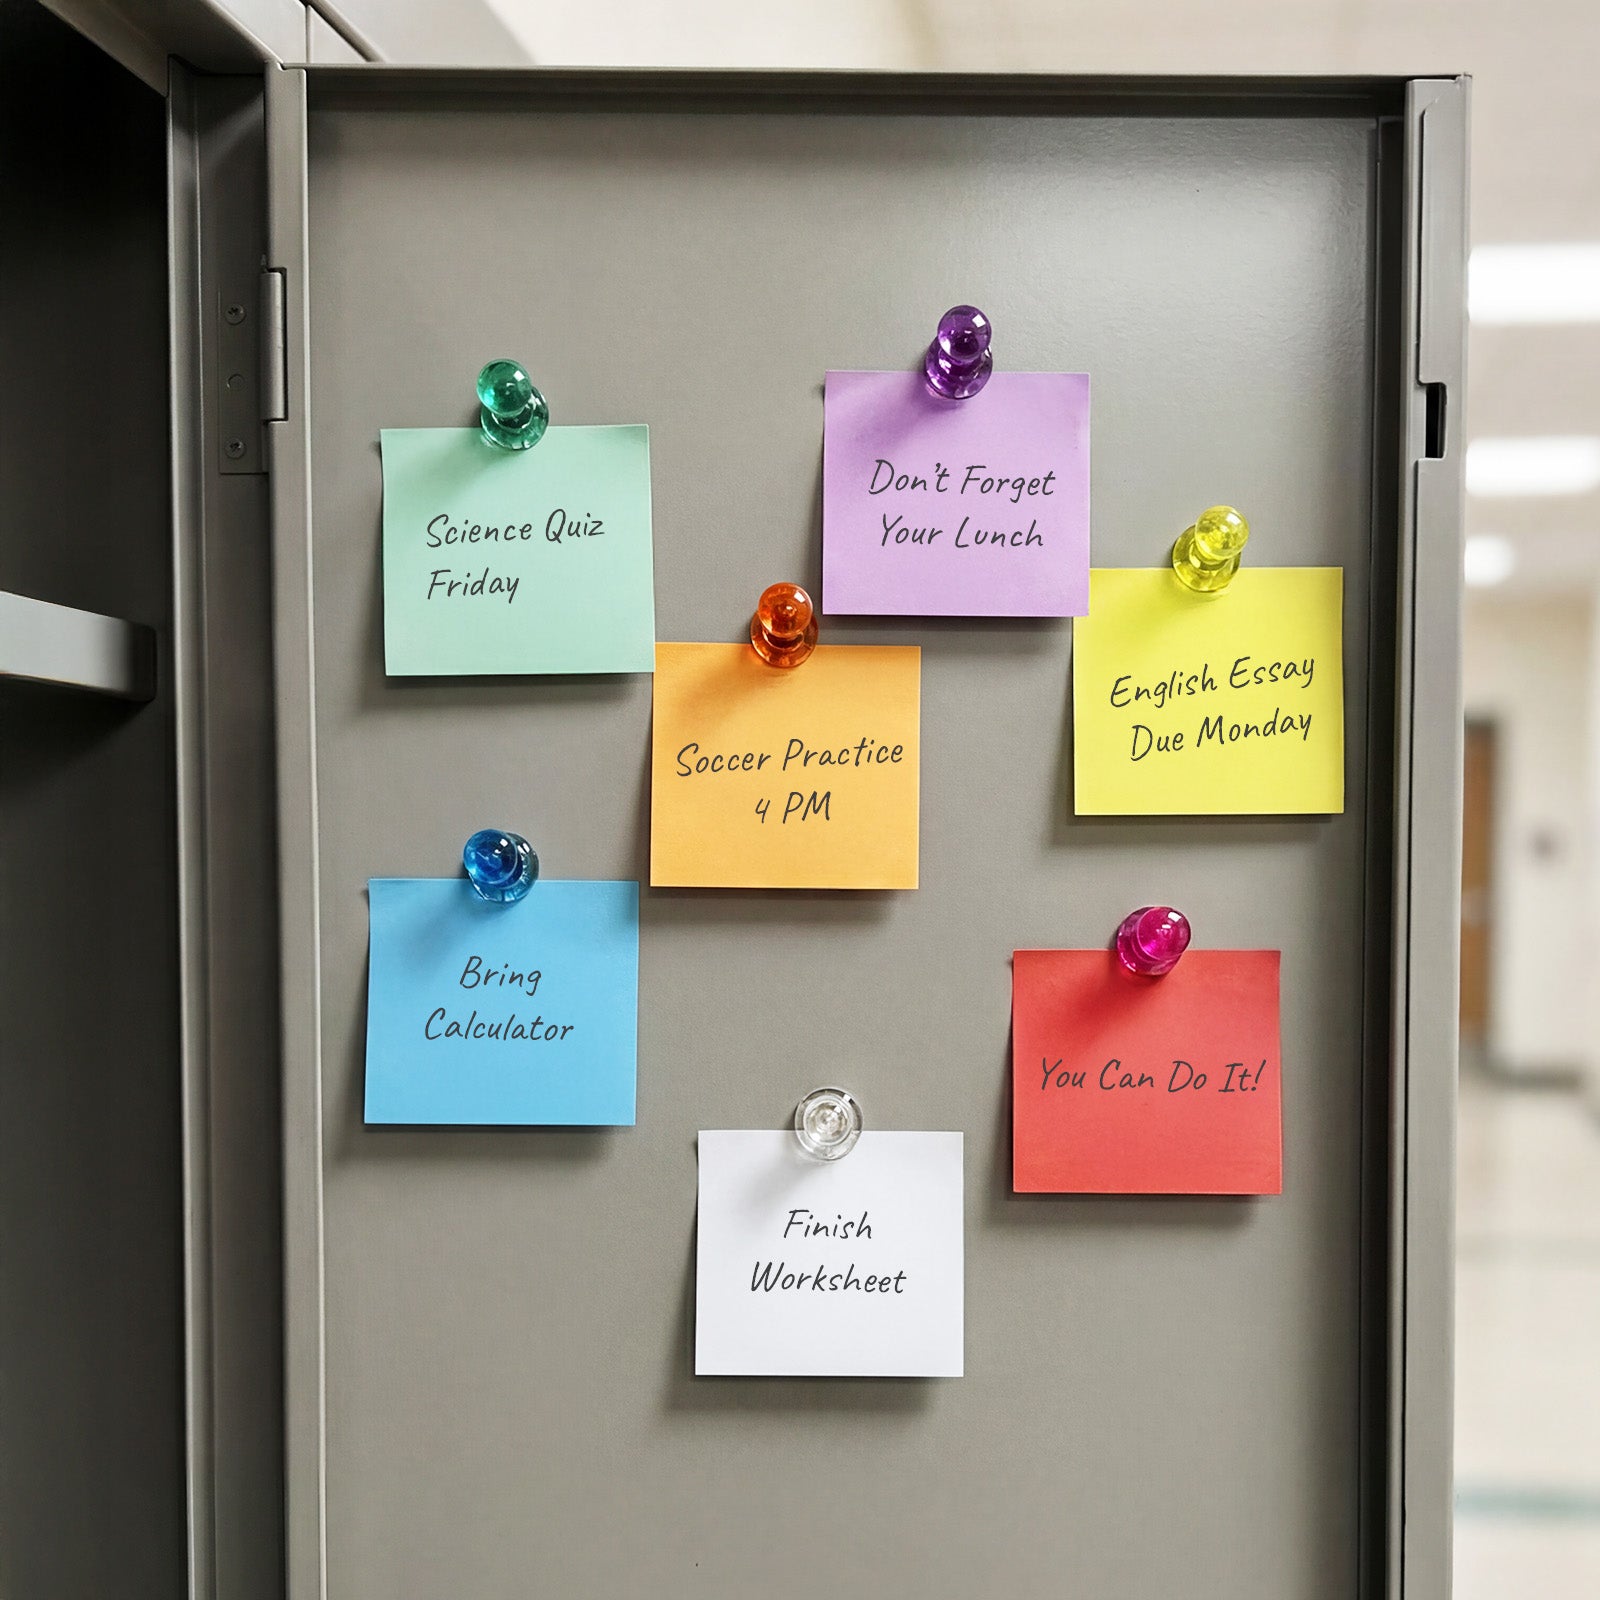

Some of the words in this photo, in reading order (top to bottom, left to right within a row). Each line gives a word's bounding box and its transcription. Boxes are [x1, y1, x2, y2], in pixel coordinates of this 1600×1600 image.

[869, 459, 950, 496] Don't
[961, 465, 1056, 504] Forget
[427, 513, 533, 549] Science
[546, 508, 605, 544] Quiz
[882, 513, 944, 547] Your
[955, 516, 1044, 549] Lunch
[427, 567, 520, 605] Friday
[1111, 663, 1218, 709] English
[1229, 656, 1315, 689] Essay
[1130, 724, 1184, 762] Due
[1197, 708, 1313, 748] Monday
[677, 743, 772, 777] Soccer
[783, 737, 904, 772] Practice
[755, 798, 771, 824] 4
[783, 791, 832, 825] PM
[460, 956, 542, 997] Bring
[425, 1008, 575, 1041] Calculator
[1042, 1057, 1087, 1091] You
[1100, 1059, 1155, 1091] Can
[1168, 1061, 1208, 1093] Do
[1218, 1059, 1267, 1093] It!
[784, 1209, 872, 1240] Finish
[751, 1262, 907, 1294] Worksheet
